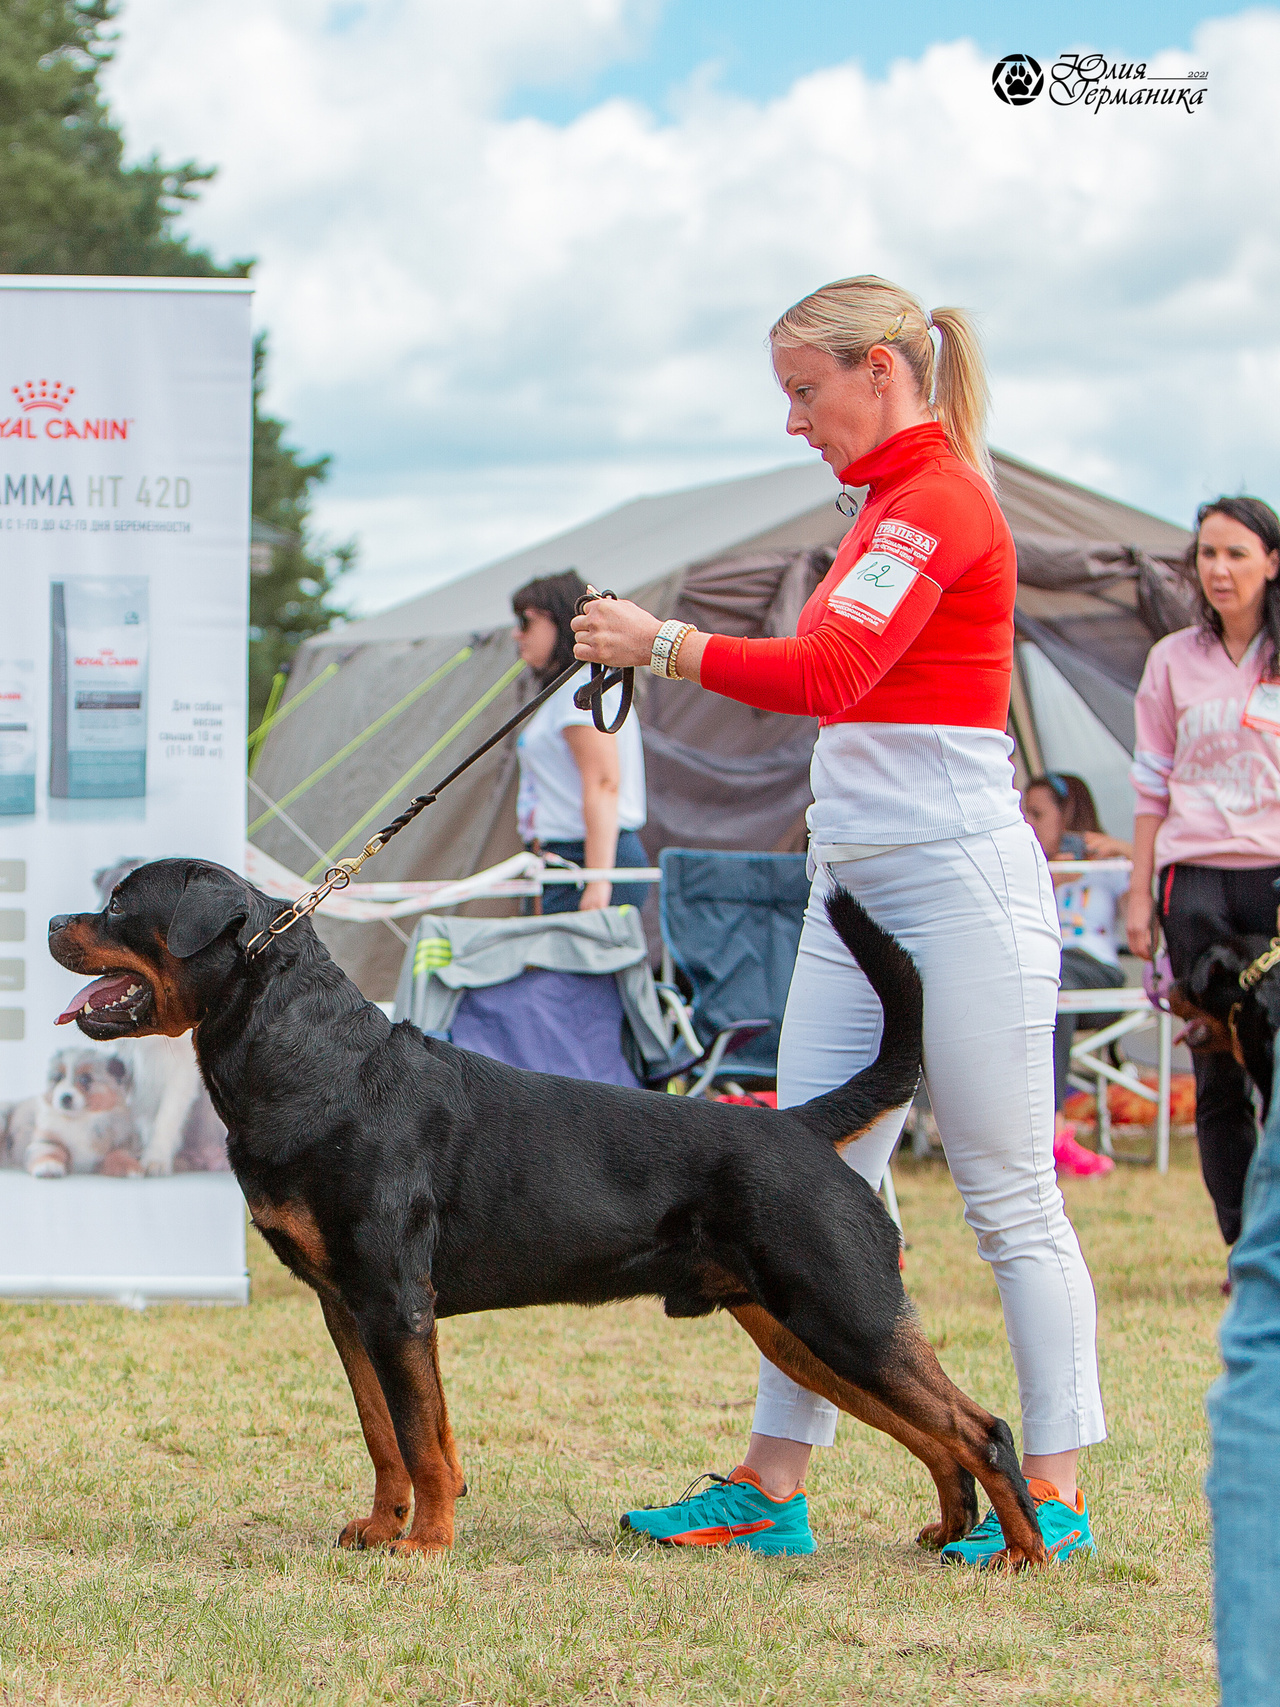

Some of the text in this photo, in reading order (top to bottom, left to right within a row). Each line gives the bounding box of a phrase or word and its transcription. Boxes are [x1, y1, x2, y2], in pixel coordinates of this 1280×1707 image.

[45, 418, 128, 440] CANIN
[135, 476, 191, 508] 42D
[877, 524, 931, 551] ТРАПЕЗА
[856, 561, 895, 588] 12
